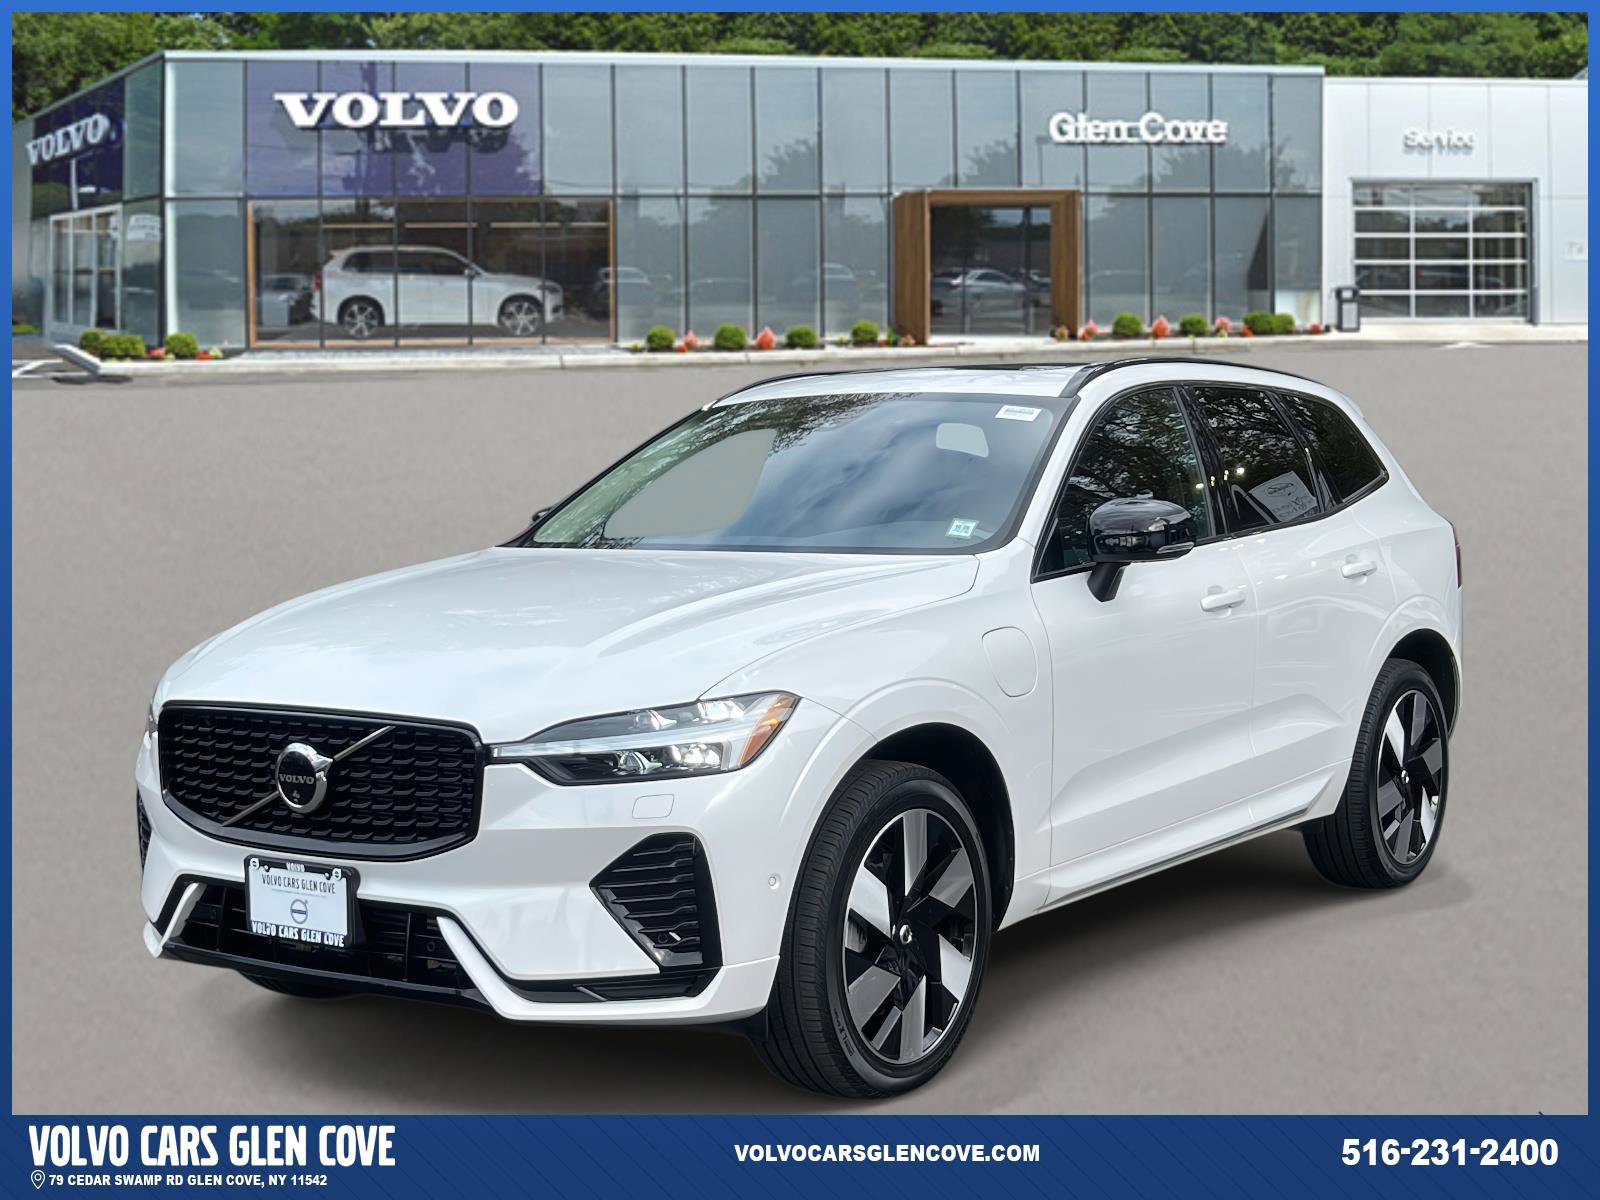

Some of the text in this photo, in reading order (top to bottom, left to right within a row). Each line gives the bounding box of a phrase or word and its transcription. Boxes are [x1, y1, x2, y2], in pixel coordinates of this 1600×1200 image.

[274, 92, 519, 129] VOLVO
[25, 113, 111, 165] VOLVO
[1049, 112, 1228, 144] Glen Cove
[1402, 127, 1475, 154] Service
[279, 773, 315, 785] VOLVO
[262, 874, 336, 894] VOLVO CARS GLEN COVE
[251, 920, 345, 948] VOLVO CARS GLEN COVE
